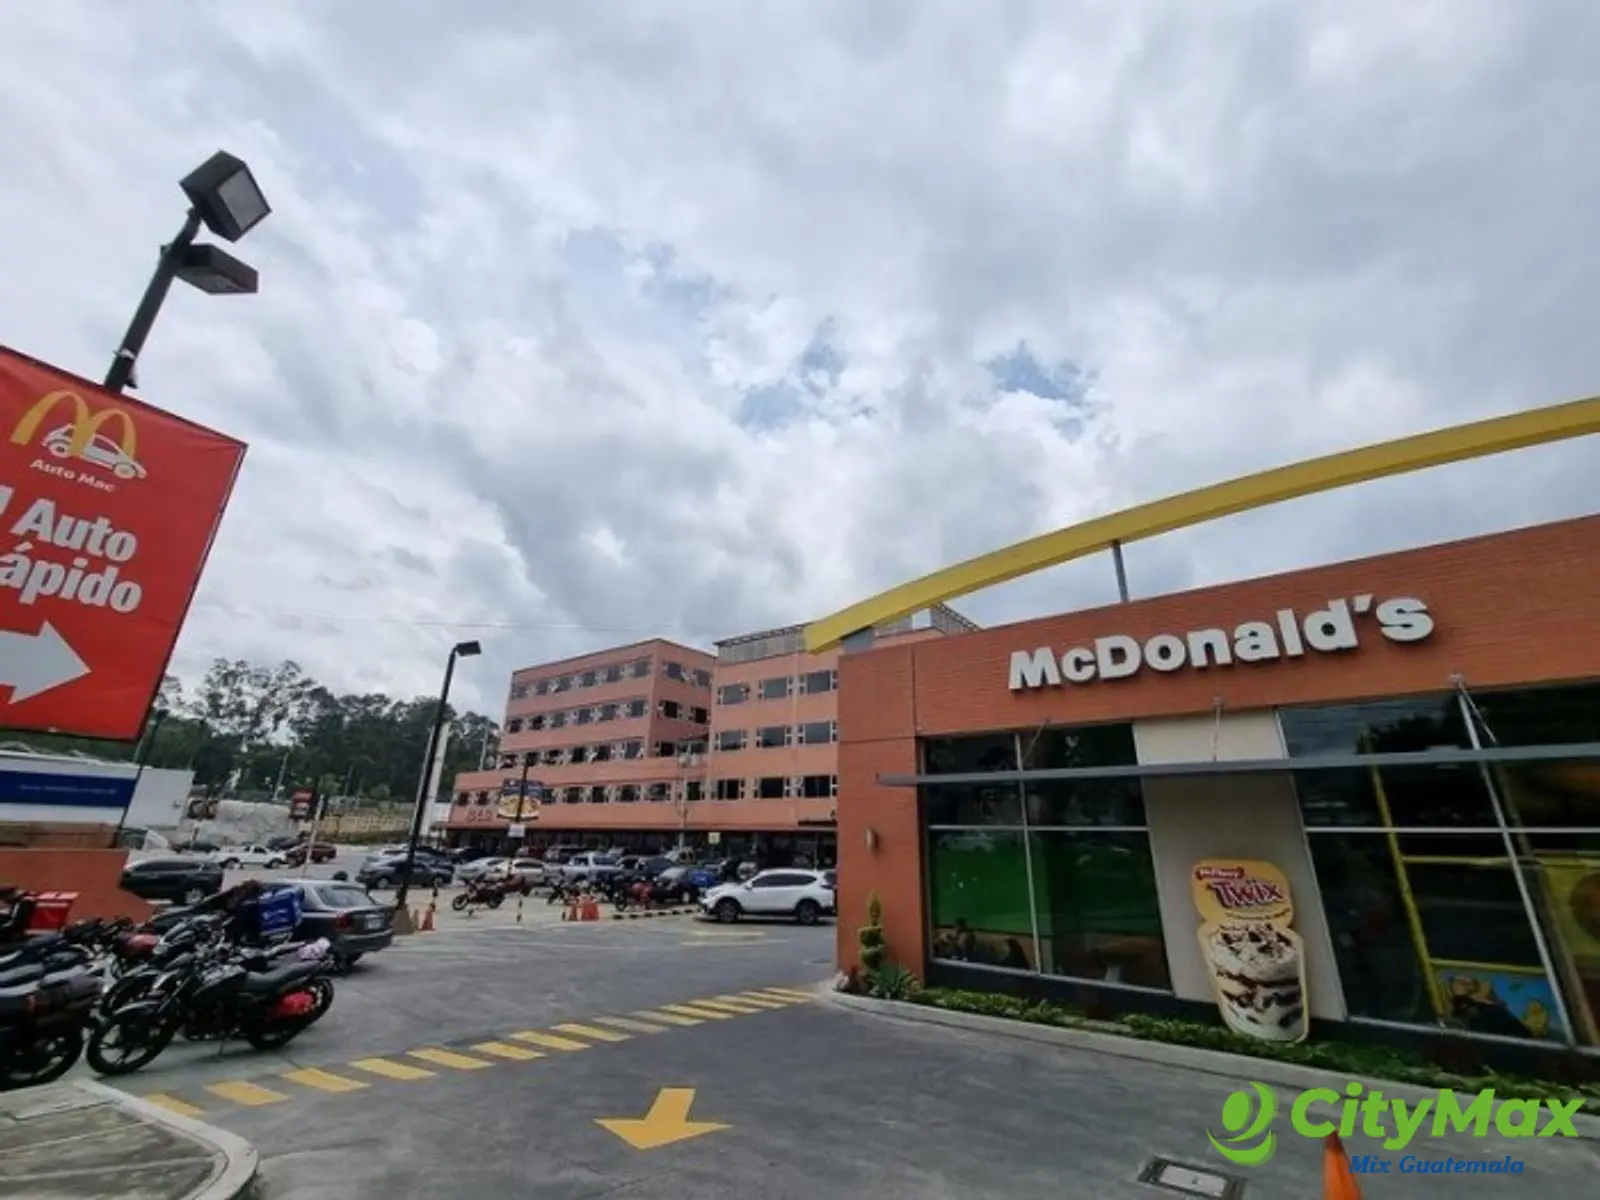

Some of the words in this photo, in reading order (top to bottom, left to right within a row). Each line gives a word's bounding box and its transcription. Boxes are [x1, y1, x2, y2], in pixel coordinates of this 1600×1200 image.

[30, 459, 75, 480] Auto
[77, 472, 115, 492] Mac
[9, 498, 137, 562] Auto
[0, 541, 142, 613] ápido
[1008, 593, 1434, 691] McDonald's
